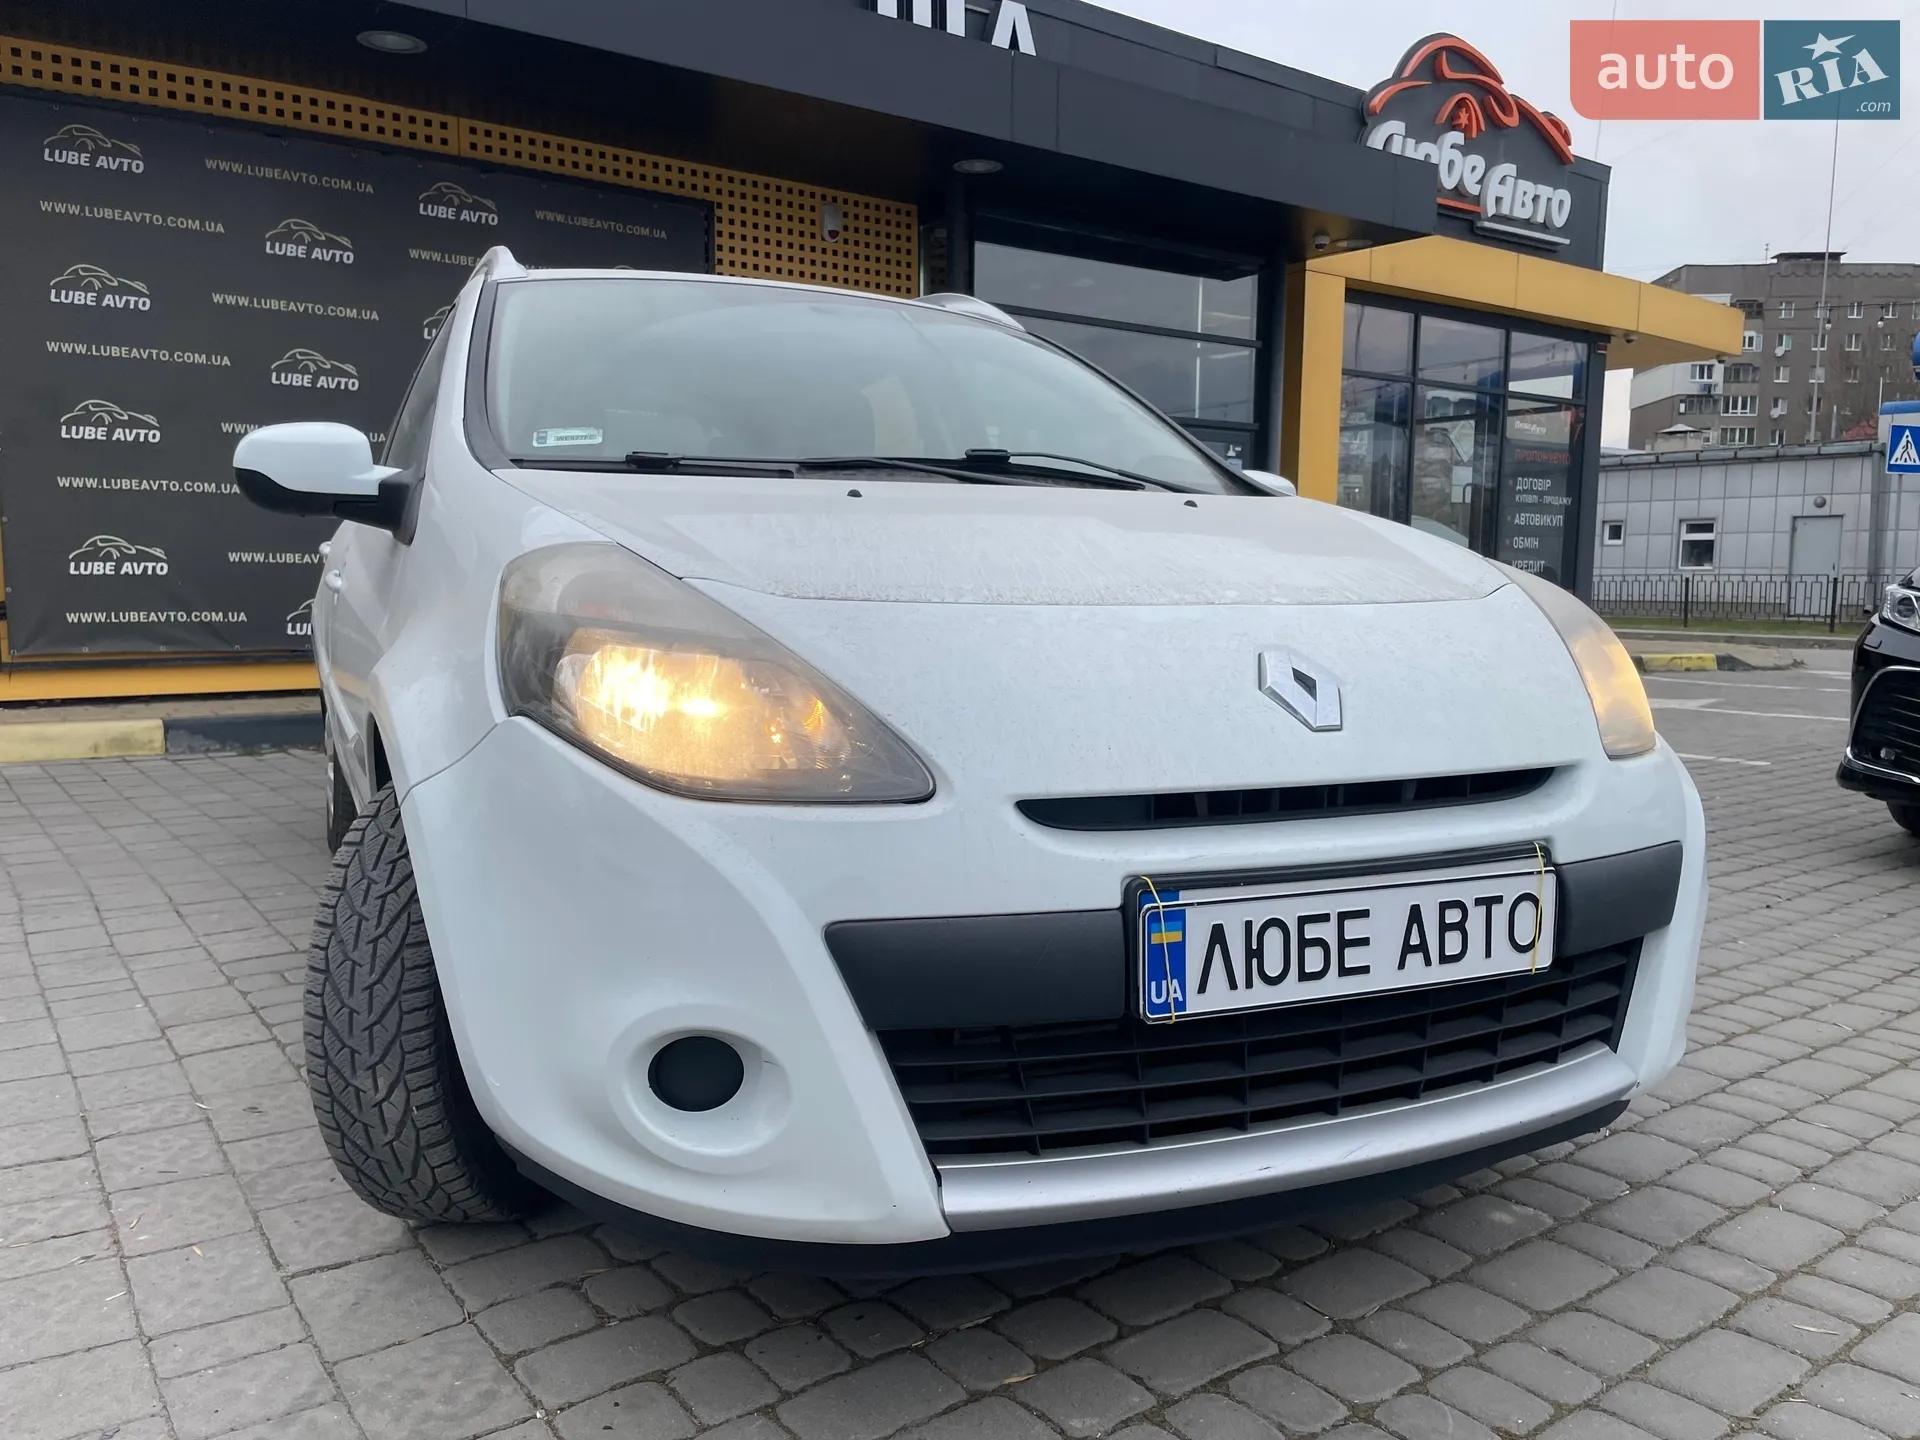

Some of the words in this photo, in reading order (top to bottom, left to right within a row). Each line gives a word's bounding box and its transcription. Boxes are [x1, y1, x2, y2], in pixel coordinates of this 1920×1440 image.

[44, 148, 91, 167] LUBE
[96, 155, 144, 174] AVTO
[205, 157, 374, 194] WWW.LUBEAVTO.COM.UA
[40, 200, 225, 234] WWW.LUBEAVTO.COM.UA
[419, 202, 457, 220] LUBE
[460, 208, 499, 226] AVTO
[535, 209, 668, 240] WWW.LUBEAVTO.COM.UA
[265, 240, 307, 258] LUBE
[311, 246, 355, 264] AVTO
[50, 288, 97, 306] LUBE
[102, 293, 151, 311] AVTO
[212, 292, 380, 321] WWW.LUBEAVTO.COM.UA
[46, 340, 231, 367] WWW.LUBEAVTO.COM.UA
[271, 371, 312, 388] LUBE
[317, 375, 359, 391] AVTO
[61, 425, 108, 440] LUBE
[112, 427, 161, 443] AVTO
[57, 476, 240, 494] WWW.LUBEAVTO.COM.UA
[1516, 477, 1552, 492] ДОГОВІР
[1514, 513, 1563, 527] АВТОВИКУП
[1513, 537, 1539, 549] ОБМІН
[69, 561, 115, 575] LUBE
[120, 561, 169, 576] AVTO
[66, 611, 248, 624] WWW.LUBEAVTO.COM.UA
[1197, 908, 1371, 995] ЛЮБЕ
[1397, 891, 1543, 970] АВТО
[1150, 980, 1183, 1004] UA
